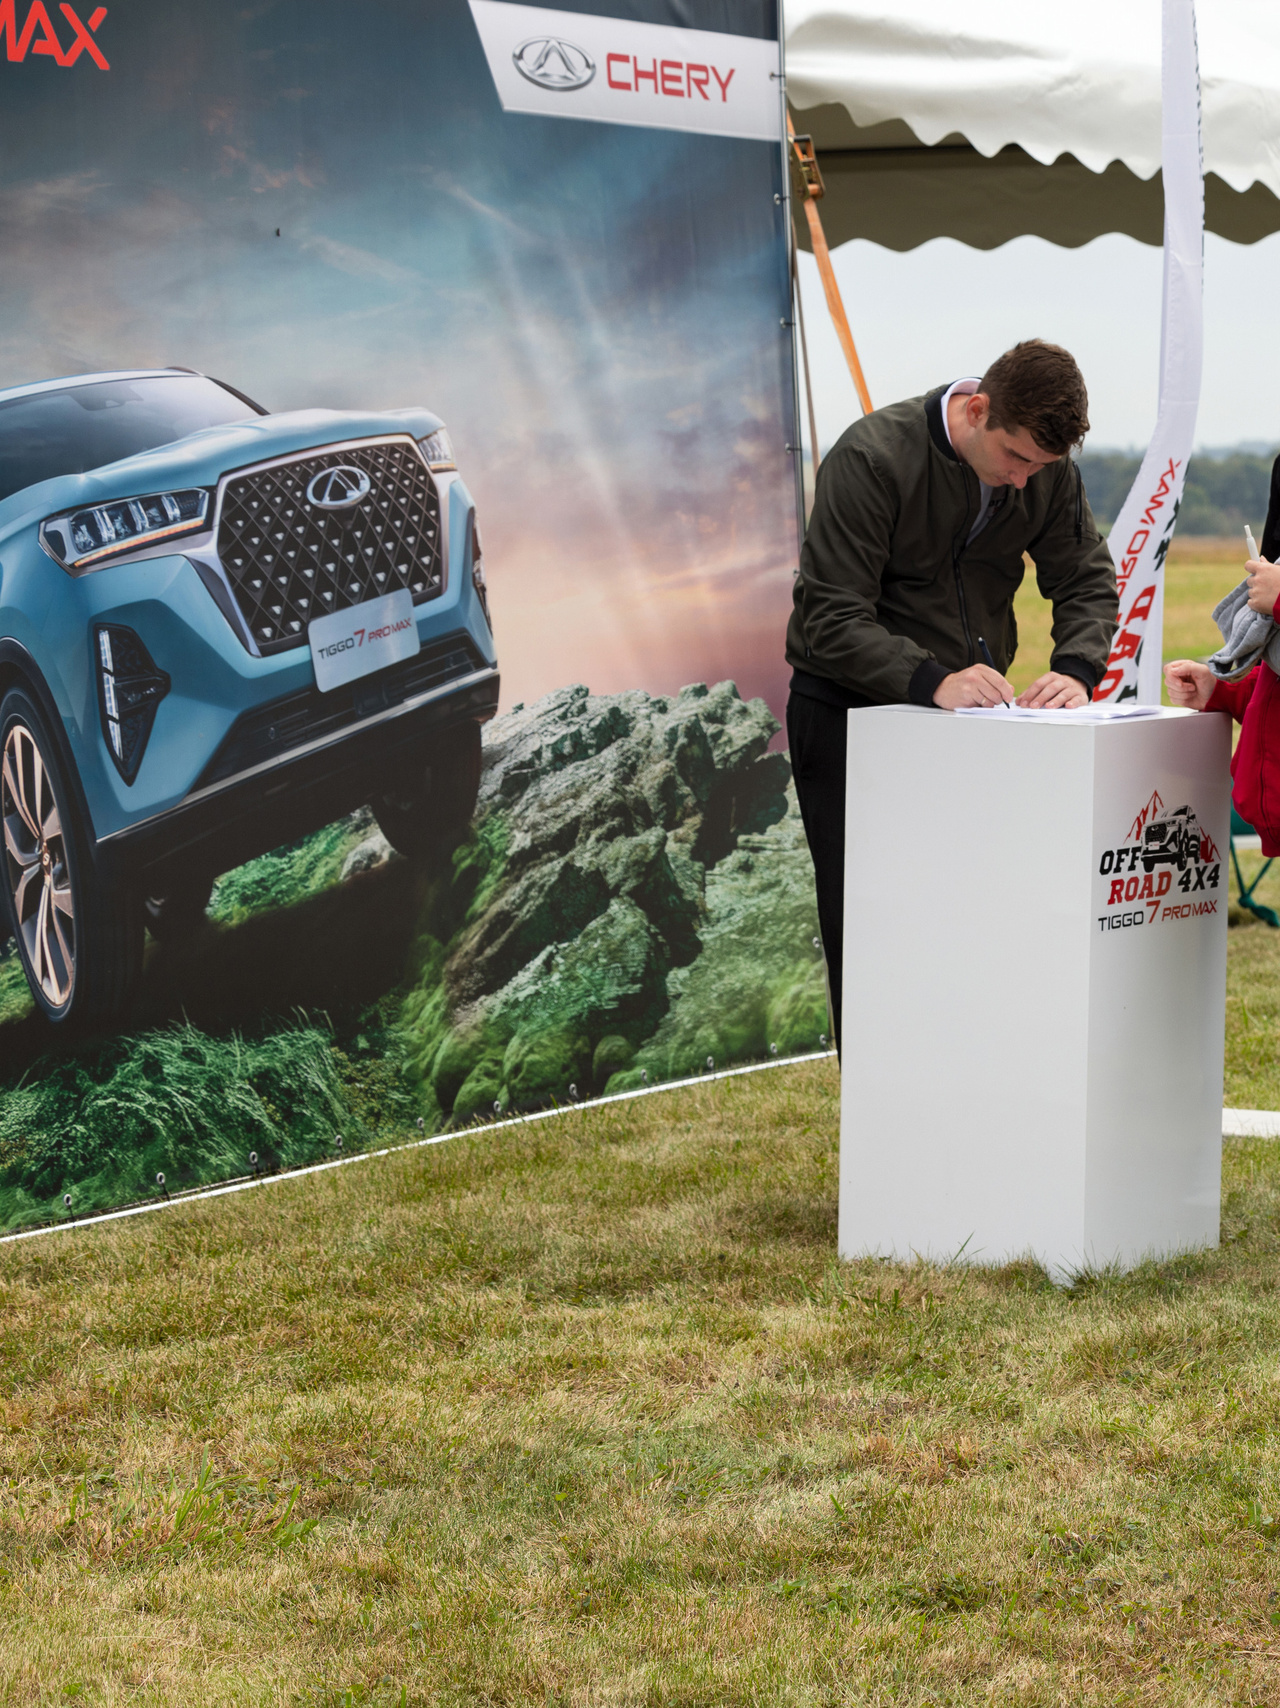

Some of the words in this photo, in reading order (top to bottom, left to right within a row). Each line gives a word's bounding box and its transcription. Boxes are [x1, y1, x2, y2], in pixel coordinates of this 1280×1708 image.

[606, 52, 736, 102] CHERY
[318, 637, 355, 659] TIGGO
[353, 628, 366, 648] 7
[1099, 846, 1143, 876] OFF
[1107, 871, 1173, 905] ROAD
[1178, 863, 1220, 893] 4X4
[1098, 910, 1144, 932] TIGGO
[1145, 899, 1162, 924] 7
